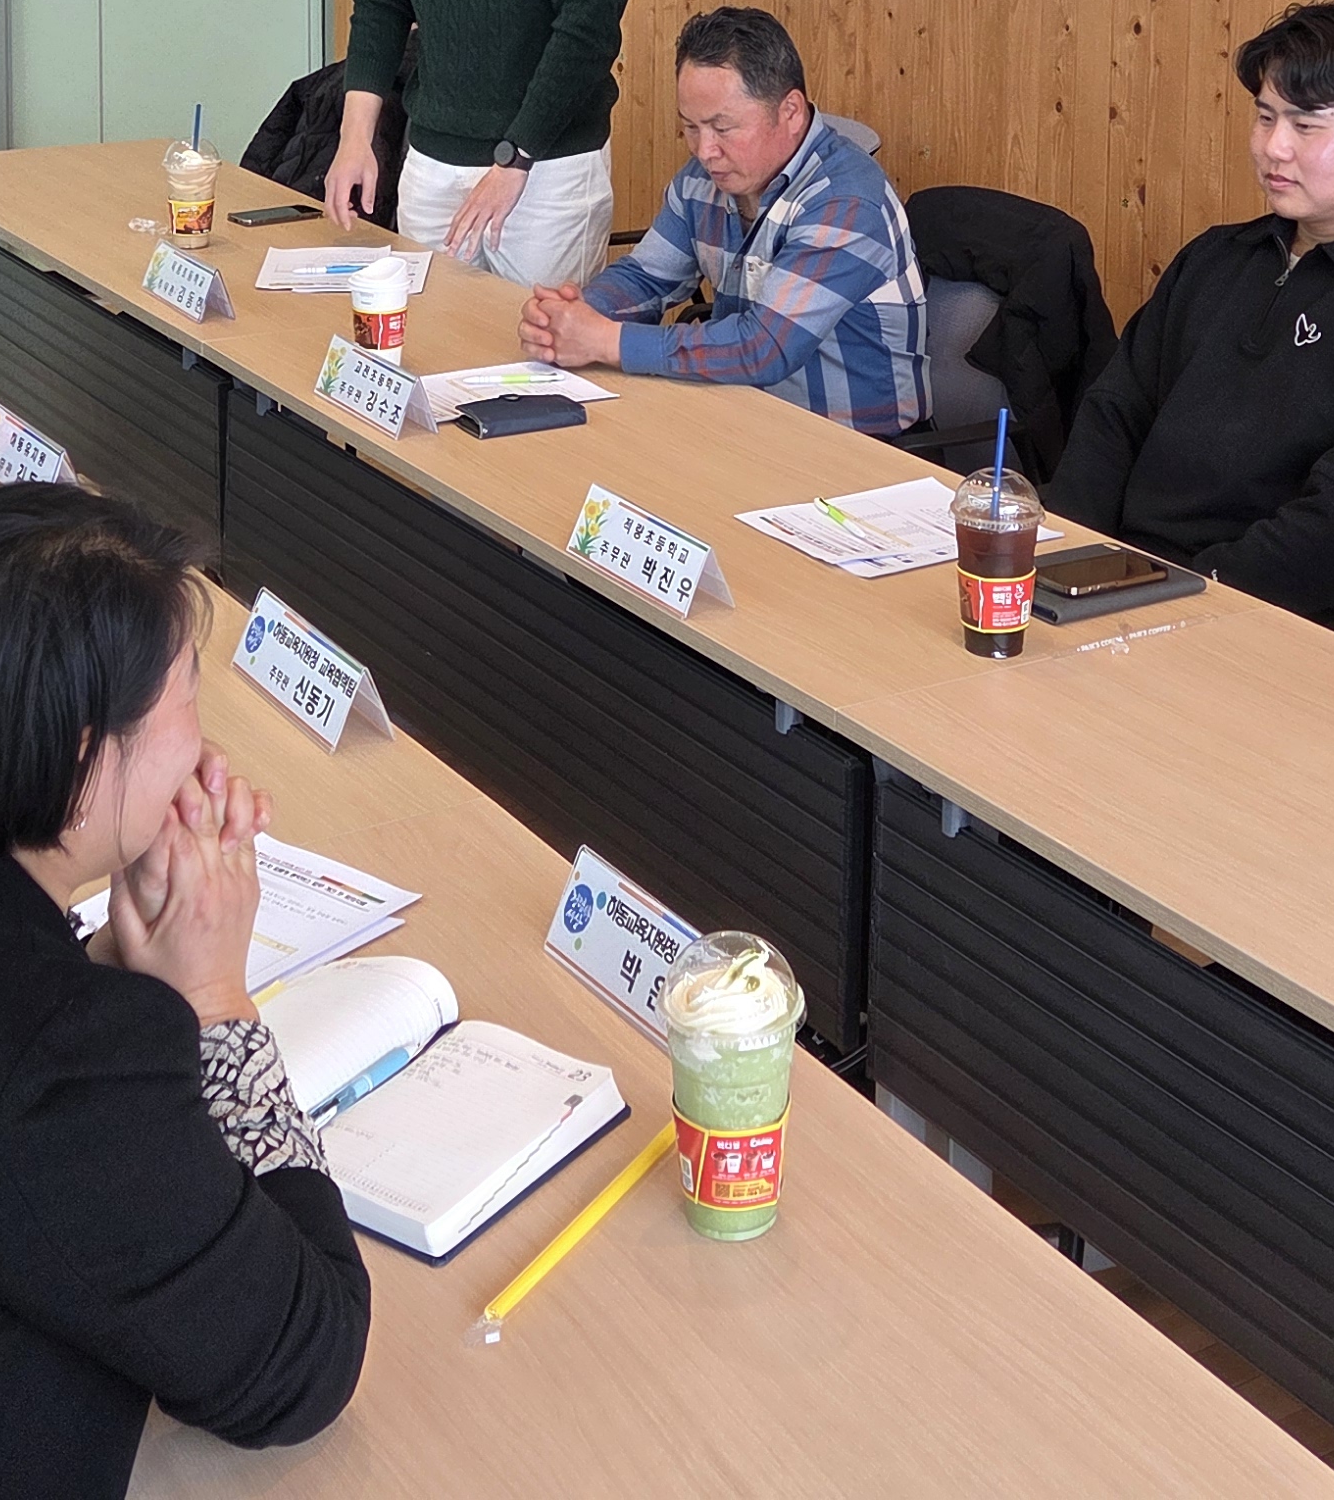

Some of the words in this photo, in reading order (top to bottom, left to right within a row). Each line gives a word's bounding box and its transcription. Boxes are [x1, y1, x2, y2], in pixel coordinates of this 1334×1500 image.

[338, 380, 363, 404] 주무관
[365, 390, 403, 426] 강수조
[353, 360, 402, 395] 고전초등학교
[598, 539, 632, 570] 주무관
[641, 555, 694, 603] 박진우
[272, 620, 321, 671] 하동교육지원청
[317, 657, 359, 700] 교육협력팀
[268, 663, 291, 692] 주무관
[292, 674, 336, 728] 신동기
[605, 893, 682, 967] 하동교육지원청
[619, 948, 644, 995] 박
